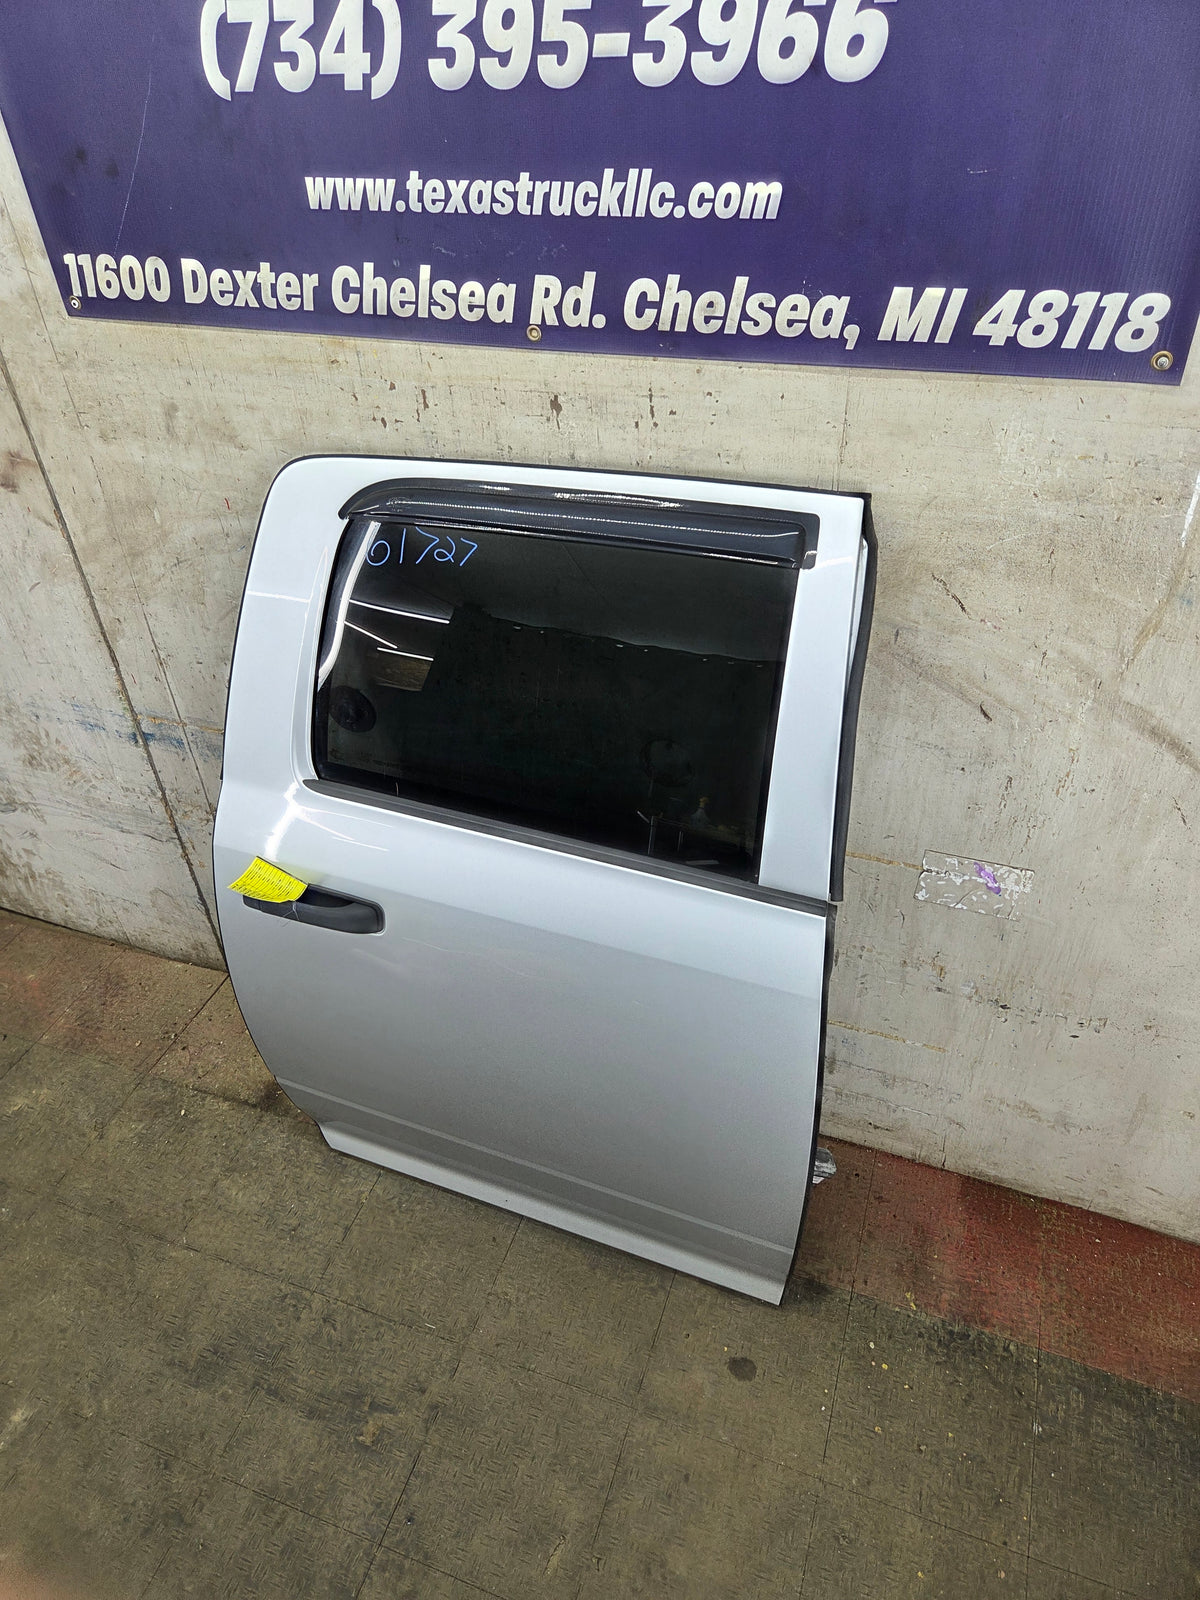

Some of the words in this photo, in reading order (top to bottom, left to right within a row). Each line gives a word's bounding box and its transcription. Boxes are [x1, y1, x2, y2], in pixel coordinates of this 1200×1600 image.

[199, 0, 402, 101] (734)
[427, 0, 897, 91] 395-3966
[304, 167, 783, 220] www.texastruckllc.com
[63, 252, 171, 303] 11600
[180, 257, 319, 312] Dexter
[331, 261, 517, 325] Chelsea
[529, 270, 607, 329] Rd.
[623, 273, 860, 351] Chelsea,
[876, 285, 968, 344] MI
[972, 288, 1172, 353] 48118
[365, 526, 479, 567] 01727
